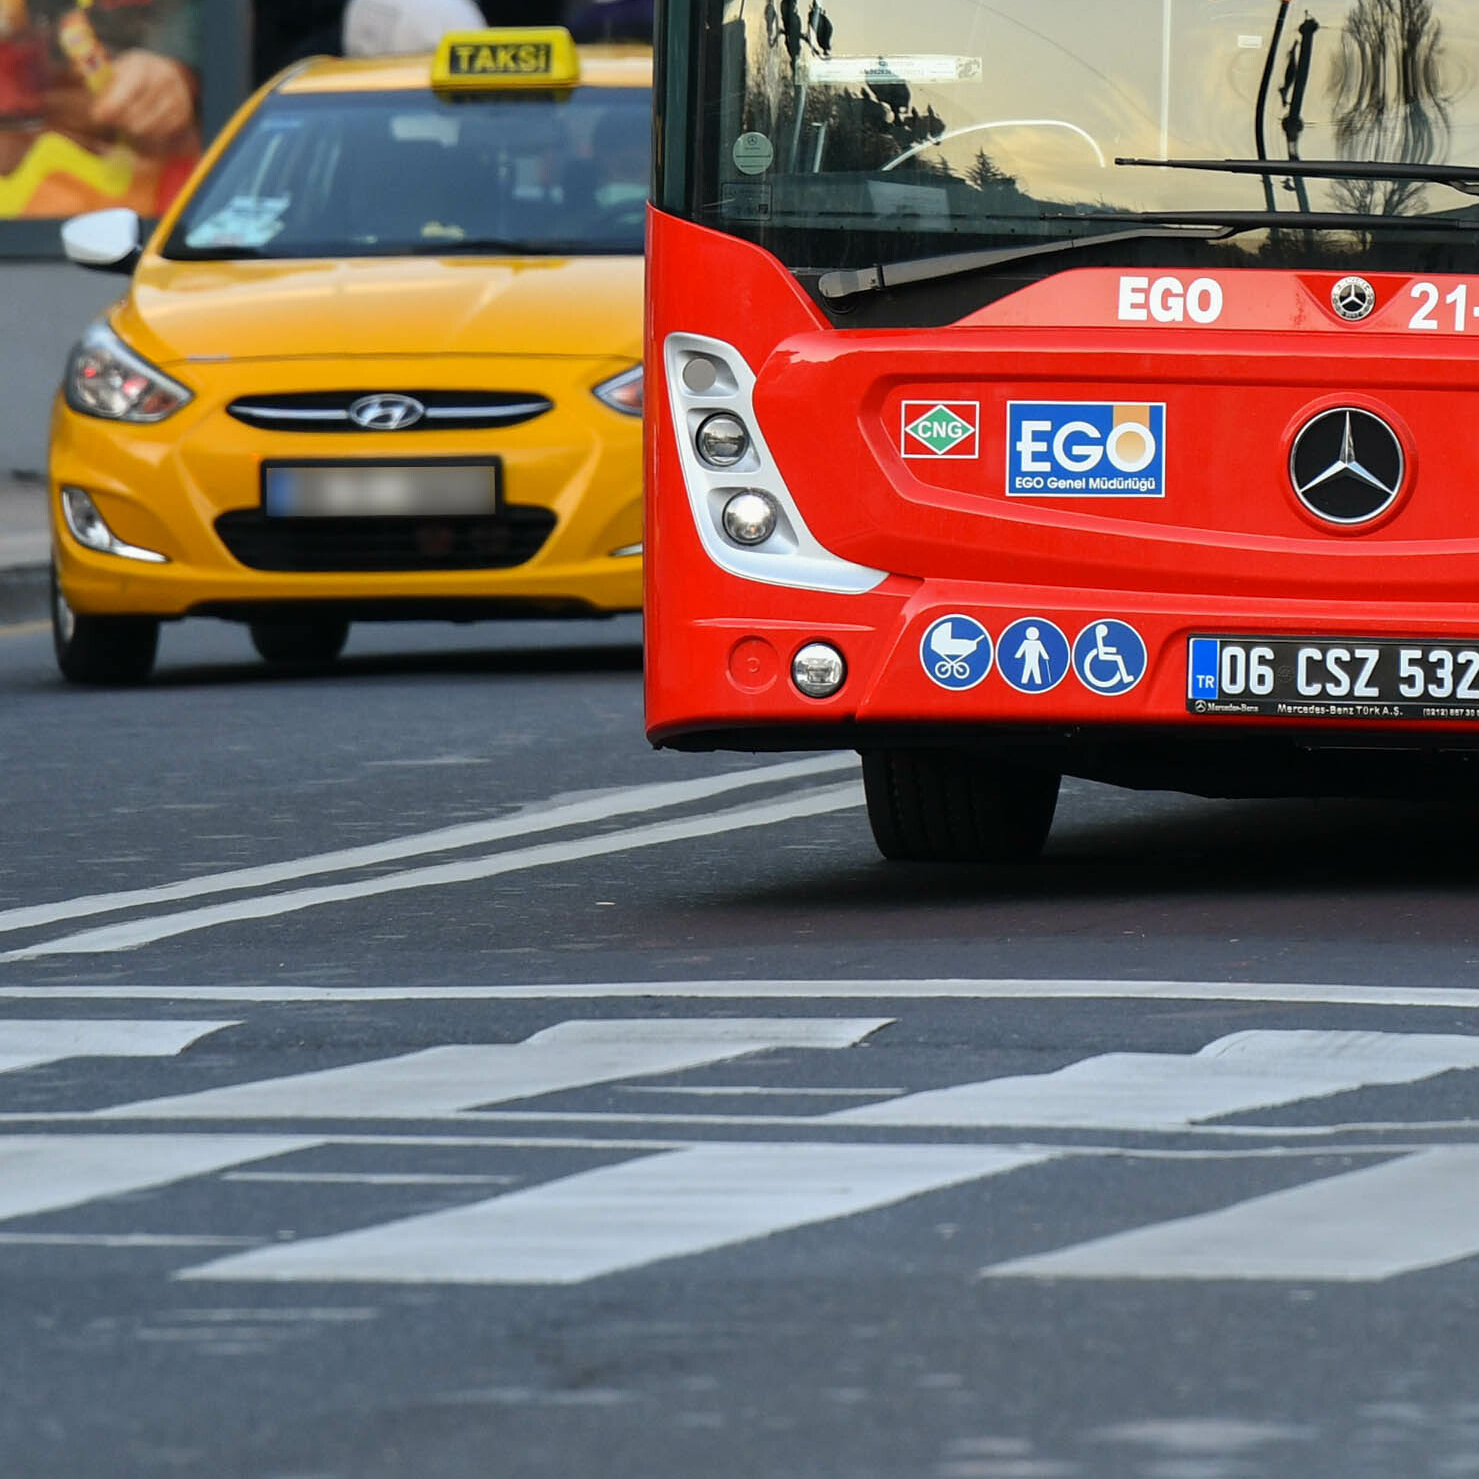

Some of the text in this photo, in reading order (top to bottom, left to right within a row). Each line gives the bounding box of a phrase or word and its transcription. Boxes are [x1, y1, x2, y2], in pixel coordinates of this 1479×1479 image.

[1117, 276, 1224, 324] EGO
[917, 421, 963, 439] CNG
[1016, 421, 1156, 472] EGO
[1015, 477, 1156, 491] EGO Genel Müdürlüğü
[1221, 646, 1275, 696] 06
[1297, 648, 1380, 698] CSZ
[1195, 674, 1215, 689] TR
[1277, 703, 1354, 716] Mercedes-Benz
